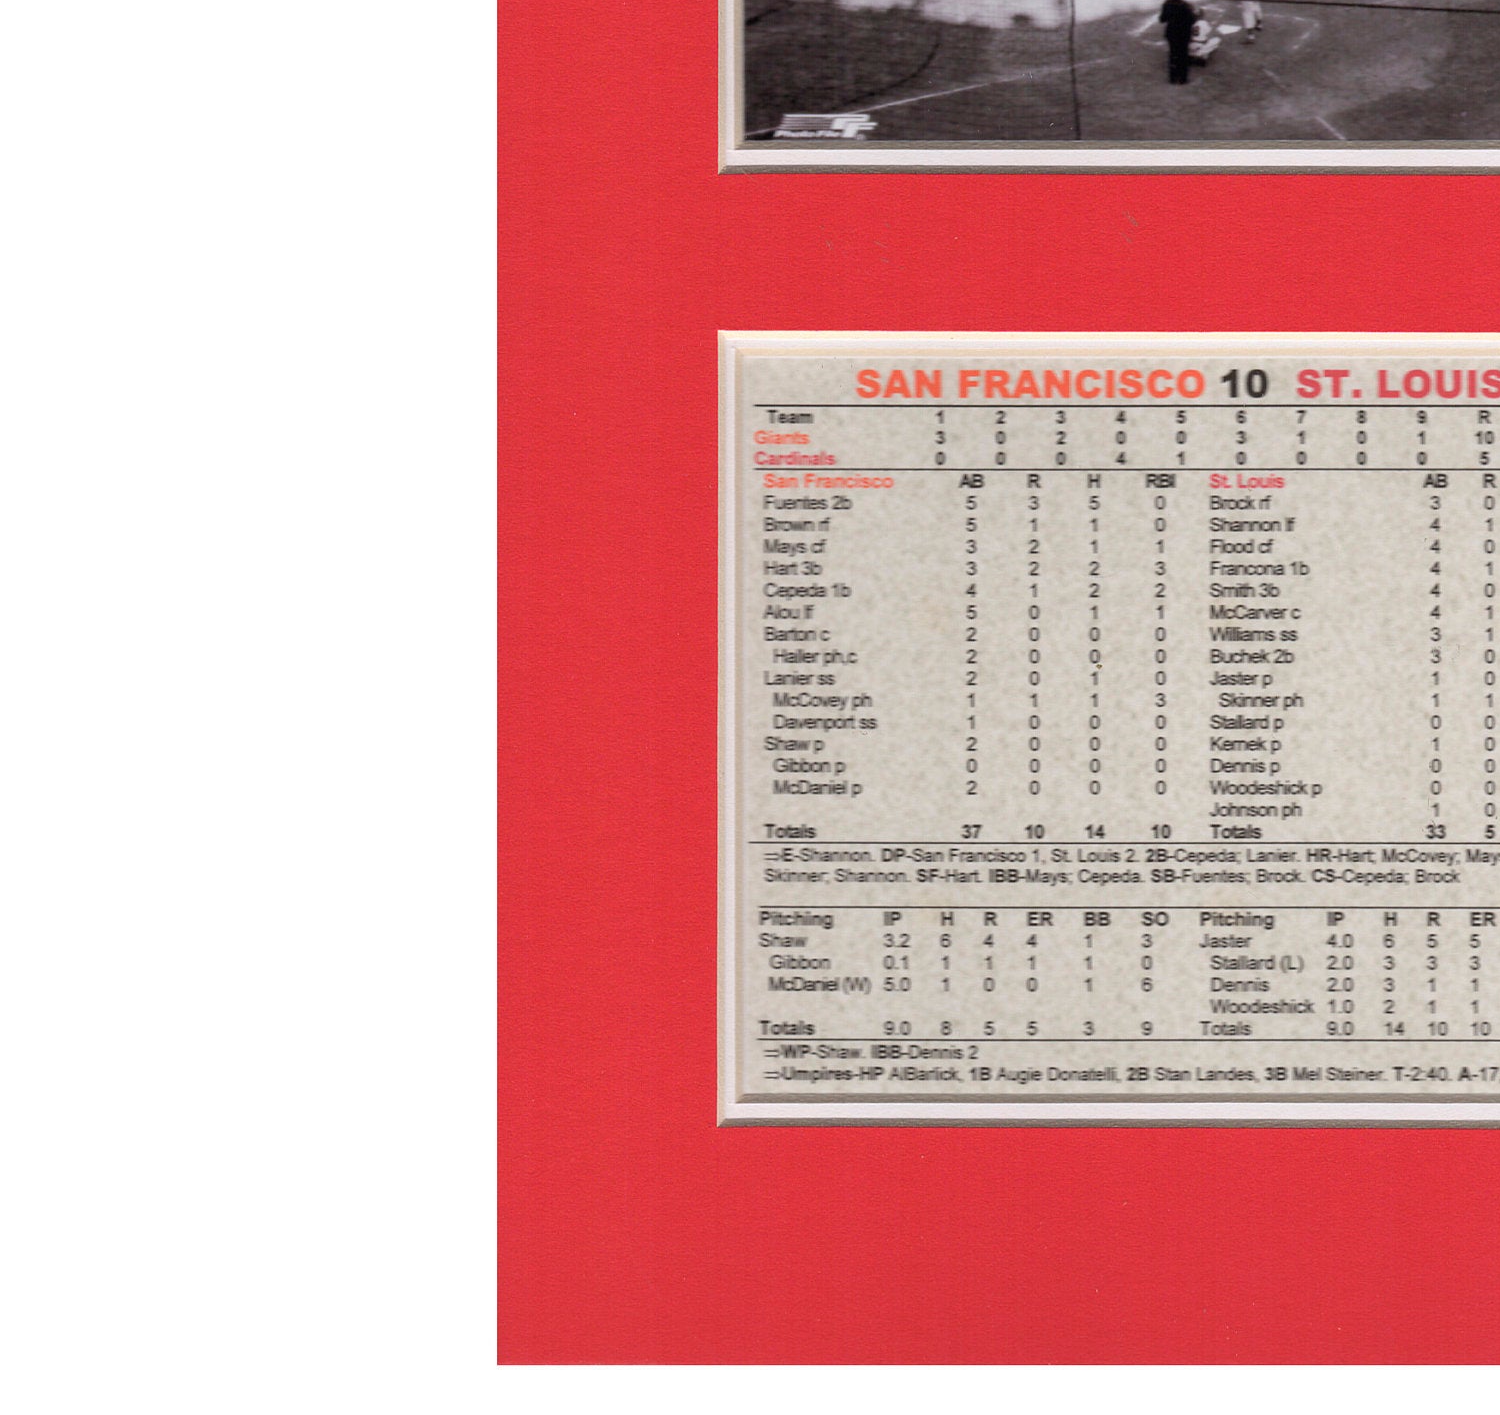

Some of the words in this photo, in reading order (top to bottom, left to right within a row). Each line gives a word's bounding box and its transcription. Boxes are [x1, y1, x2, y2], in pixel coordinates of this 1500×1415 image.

[856, 369, 942, 398] SAN
[959, 369, 1205, 399] FRANCISCO
[1221, 369, 1269, 398] 10
[1297, 369, 1361, 398] ST.
[765, 408, 815, 425] Team
[934, 409, 945, 425] 1
[994, 409, 1007, 425] 2
[1055, 409, 1067, 425] 3
[1114, 409, 1128, 425] 4
[1175, 409, 1188, 425] 5
[1235, 409, 1247, 425] 6
[1295, 409, 1308, 425] 7
[1356, 409, 1368, 425] 8
[1415, 409, 1428, 425] 9
[1477, 409, 1492, 425] R
[762, 494, 829, 511] Fuentes
[830, 494, 853, 511] 2b
[965, 495, 978, 511] 5
[1027, 495, 1040, 511] 3
[1088, 495, 1101, 511] 5
[1154, 495, 1167, 511] 0
[767, 976, 840, 992] McDaniel
[841, 976, 872, 995] (W)
[882, 976, 912, 993] 5.0
[941, 977, 950, 992] 1
[983, 976, 996, 993] 0
[1025, 976, 1039, 993] 0
[1083, 977, 1093, 993] 1
[1141, 976, 1154, 993] 6
